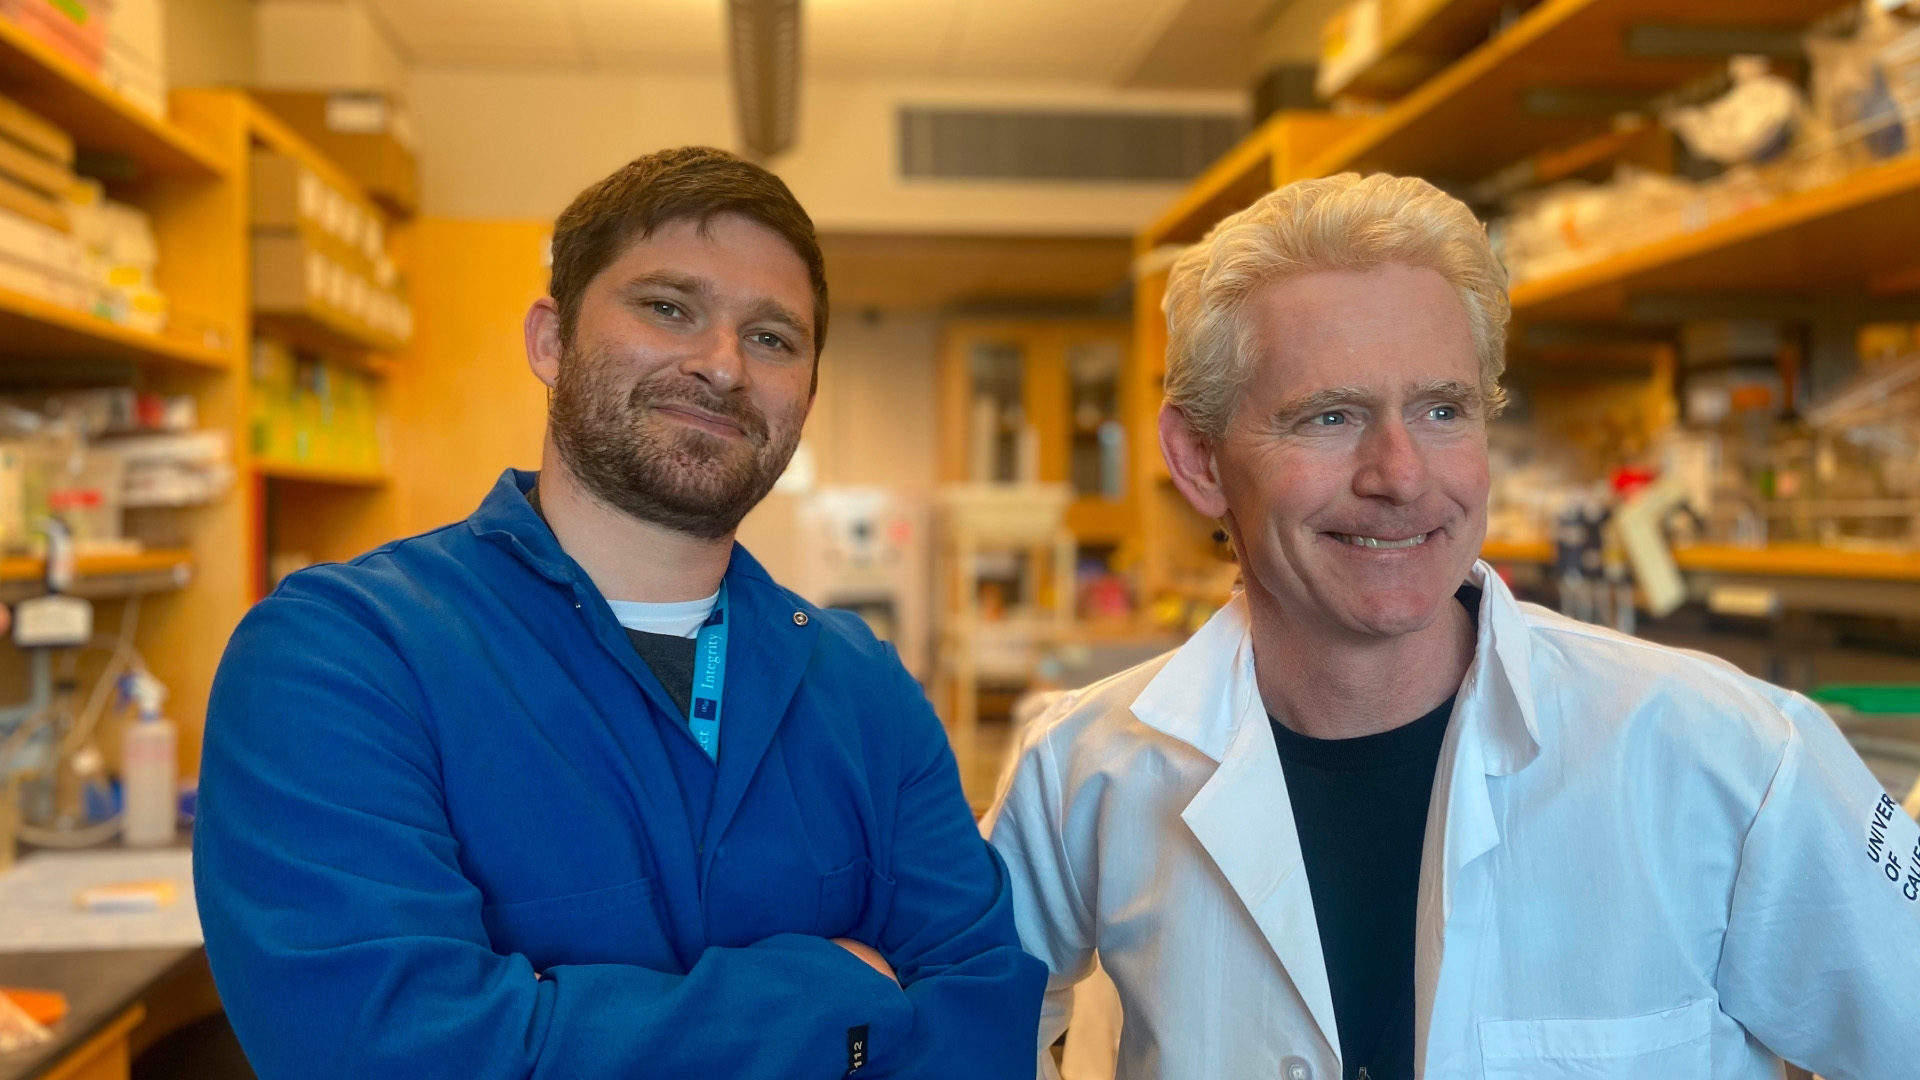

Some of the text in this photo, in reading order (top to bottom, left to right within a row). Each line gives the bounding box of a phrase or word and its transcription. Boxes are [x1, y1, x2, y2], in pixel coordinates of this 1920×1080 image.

[701, 634, 721, 689] Integrity
[1867, 793, 1897, 863] UNIVER
[1885, 851, 1902, 882] OF
[1903, 835, 1920, 901] CALIF
